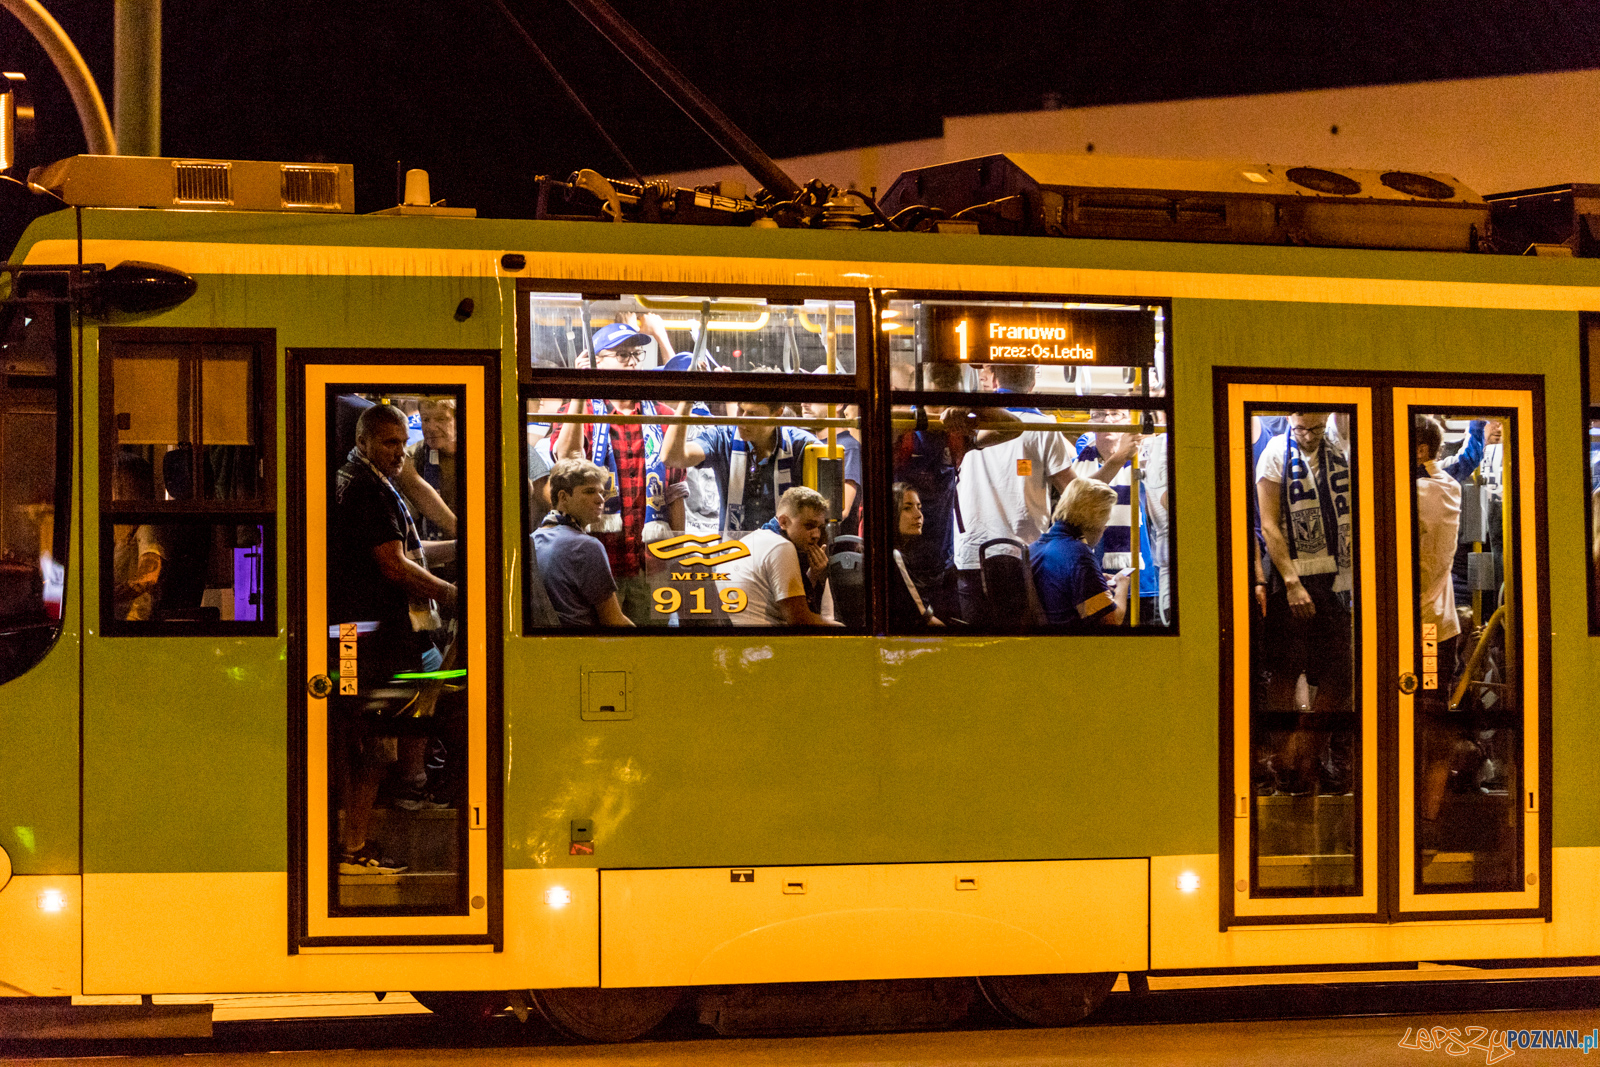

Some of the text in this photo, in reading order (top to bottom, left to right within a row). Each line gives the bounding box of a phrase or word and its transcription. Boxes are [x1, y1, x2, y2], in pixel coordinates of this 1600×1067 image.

[954, 319, 968, 360] 1
[989, 322, 1067, 341] Franowo
[670, 572, 732, 581] MPK
[652, 586, 749, 614] 919
